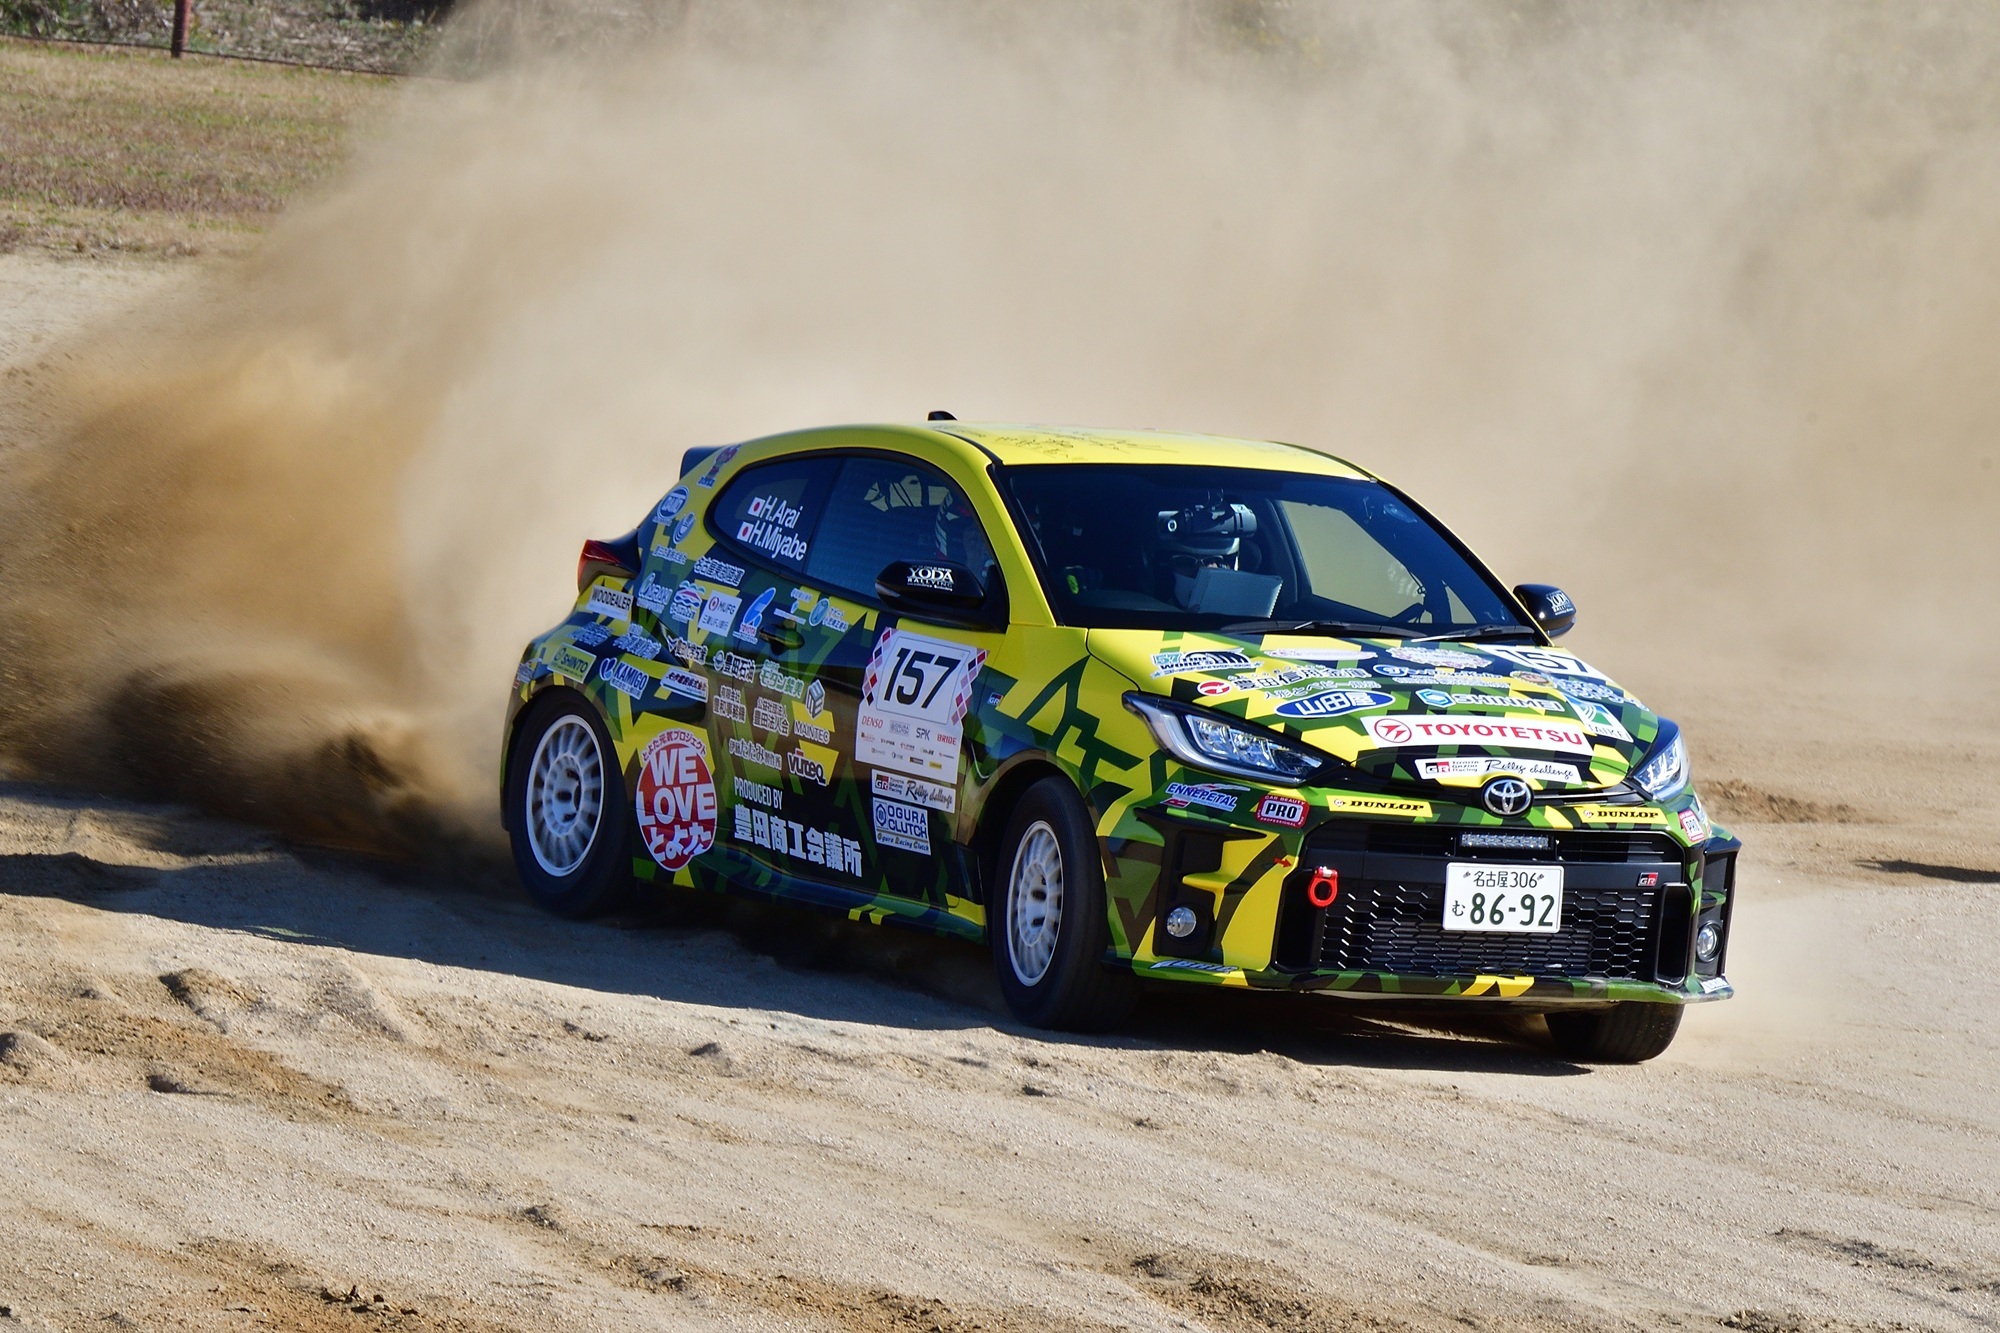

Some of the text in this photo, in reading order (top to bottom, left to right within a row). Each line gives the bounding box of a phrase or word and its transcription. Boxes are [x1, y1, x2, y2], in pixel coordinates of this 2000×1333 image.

[760, 495, 804, 529] H.Arai
[750, 520, 808, 561] H.Miyabe
[909, 567, 954, 584] YODA
[592, 586, 632, 611] WOODEALER
[561, 653, 589, 673] SHINTO
[1155, 654, 1179, 665] 57
[1493, 649, 1588, 673] 157
[614, 660, 649, 690] KAMIGO
[884, 648, 961, 709] 157
[1295, 692, 1376, 715] 山田屋
[1453, 692, 1565, 712] SHINMEI
[861, 715, 884, 729] DENSO
[916, 727, 931, 741] SPK
[937, 734, 957, 746] BRIDE
[1415, 723, 1582, 745] TOYOTETSU
[642, 730, 706, 761] とよた元気プロジェクト
[651, 748, 698, 787] WE
[1426, 764, 1450, 774] GR
[1529, 764, 1574, 780] challenge
[734, 776, 783, 810] PRODUCED BY
[1166, 783, 1238, 808] ENNEPETAL
[637, 783, 716, 826] LOVE
[887, 805, 927, 825] OGURA
[1264, 802, 1298, 820] PRO
[1349, 800, 1425, 812] DUNLOP
[1597, 810, 1659, 819] DUNLOP
[888, 819, 928, 839] CLUTCH
[648, 822, 711, 862] とよた
[734, 804, 862, 877] 豊田商工会議所
[895, 837, 912, 847] Racing
[913, 840, 929, 851] Clutch
[1638, 877, 1657, 886] GR
[1451, 892, 1555, 927] む 86-92
